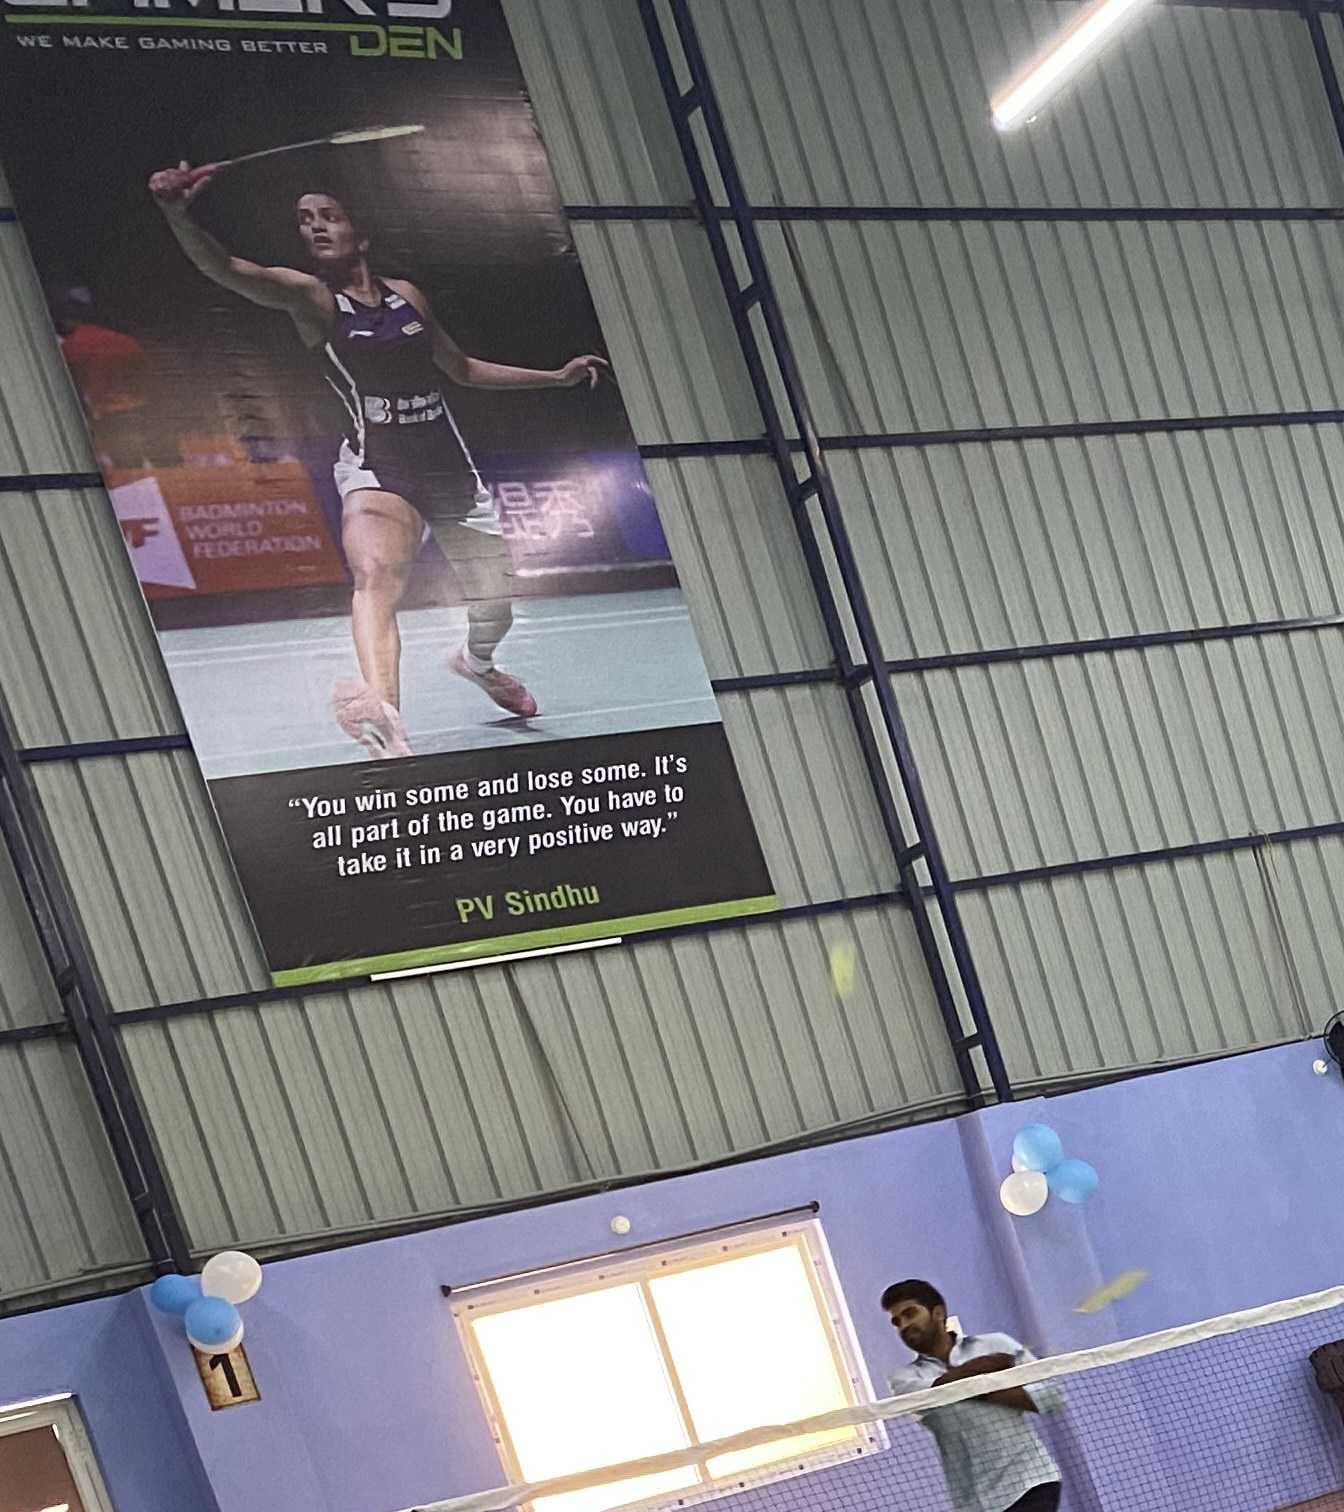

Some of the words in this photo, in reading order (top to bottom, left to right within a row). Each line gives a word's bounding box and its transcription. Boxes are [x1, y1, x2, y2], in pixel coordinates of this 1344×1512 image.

[17, 35, 53, 48] WE
[62, 35, 130, 50] MAKE
[139, 36, 232, 52] GAMING
[242, 38, 329, 55] BETTER
[349, 25, 463, 60] DEN
[178, 501, 307, 521] BADMINTON
[186, 520, 263, 540] WORLD
[193, 536, 321, 559] FEDERATION
[355, 789, 397, 812] win
[405, 785, 469, 807] some
[477, 773, 520, 797] and
[528, 769, 574, 792] lose
[581, 763, 647, 785] some.
[312, 825, 342, 849] all
[351, 820, 400, 848] part
[407, 814, 430, 837] of
[438, 808, 475, 833] the
[482, 802, 553, 830] game.
[560, 794, 600, 816] You
[607, 787, 658, 812] have
[663, 784, 684, 804] to
[338, 852, 387, 877] take
[395, 848, 412, 869] it
[420, 843, 442, 865] in
[449, 843, 464, 861] a
[471, 834, 521, 860] very
[528, 823, 614, 855] positive
[455, 895, 494, 924] PV
[504, 883, 600, 917] Sindhu
[208, 1353, 242, 1398] 1
